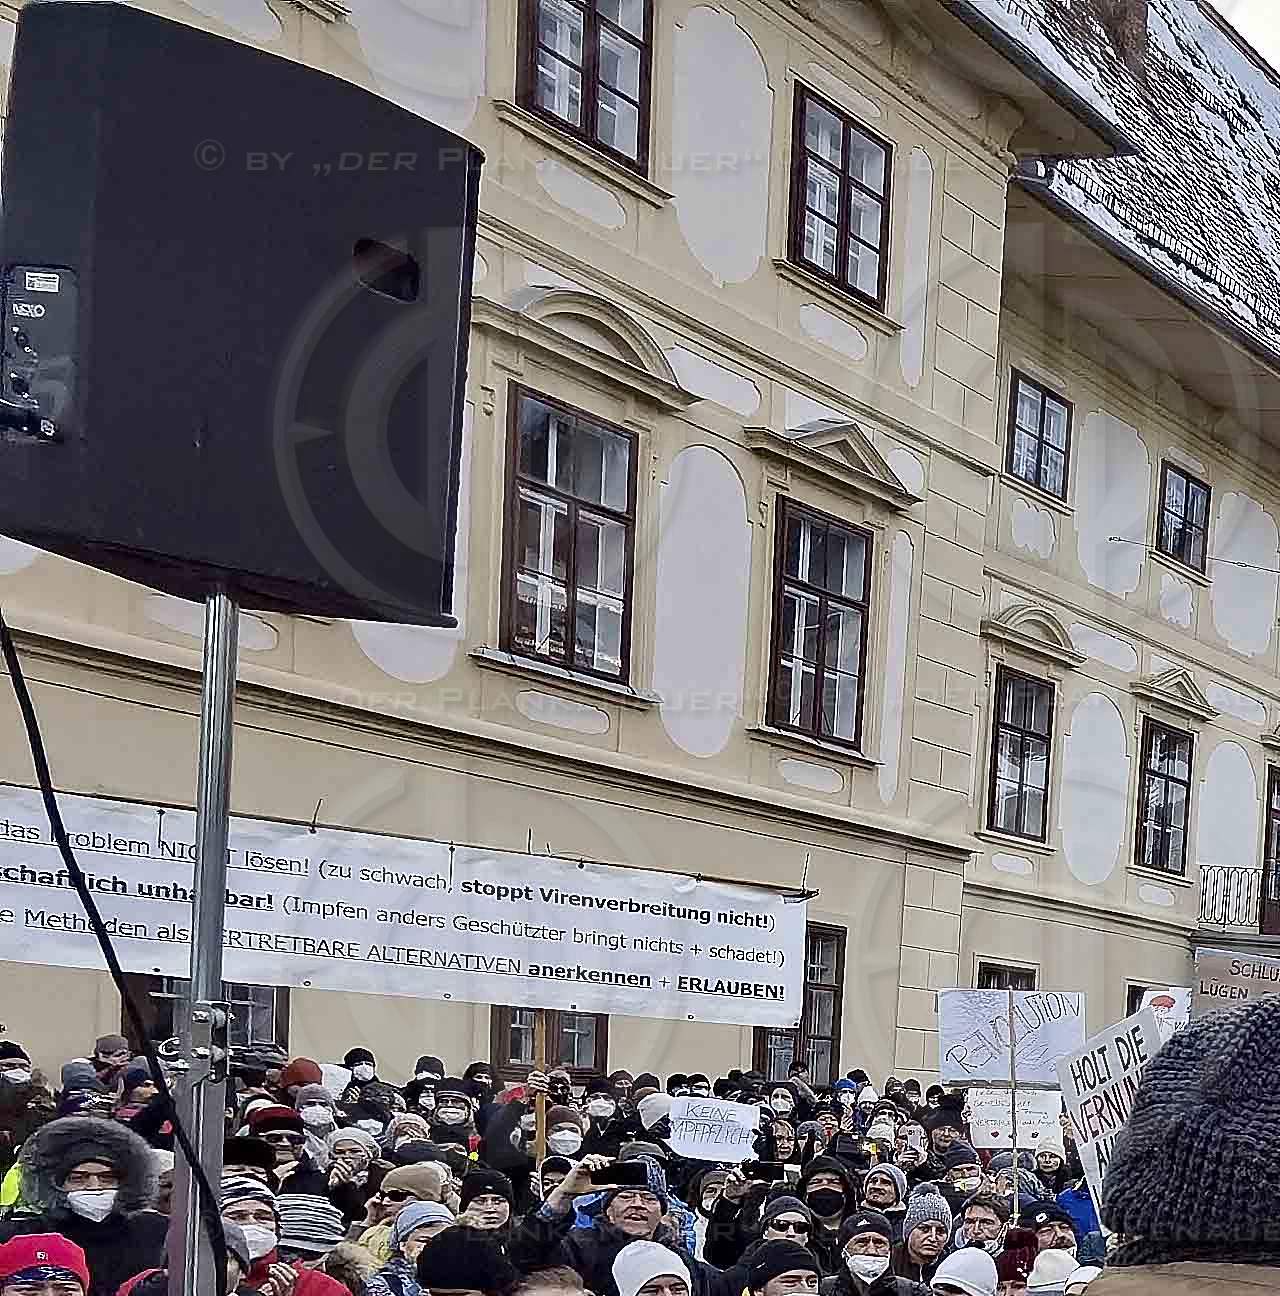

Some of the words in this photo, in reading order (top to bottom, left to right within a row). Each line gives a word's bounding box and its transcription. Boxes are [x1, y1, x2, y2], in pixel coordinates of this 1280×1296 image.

[245, 850, 309, 873] lösen!
[318, 859, 351, 879] (zu
[360, 866, 452, 893] schwach,
[461, 878, 540, 903] stoppt
[541, 886, 711, 925] Virenverbreitung
[717, 911, 776, 934] nicht!)
[157, 923, 190, 942] als
[367, 945, 521, 976] ALTERNATIVEN
[528, 961, 652, 988] anerkennen
[659, 977, 671, 989] +
[677, 976, 785, 1000] ERLAUBEN!
[283, 895, 368, 921] (Impfen
[376, 909, 446, 930] anders
[453, 915, 567, 943] Geschützter
[573, 929, 627, 951] bringt
[633, 938, 684, 955] nichts
[690, 944, 702, 956] +
[709, 945, 785, 967] schadet!)
[1200, 977, 1249, 1000] LÜGEN
[1070, 1045, 1112, 1096] HOLT
[1114, 1024, 1148, 1073] DIE
